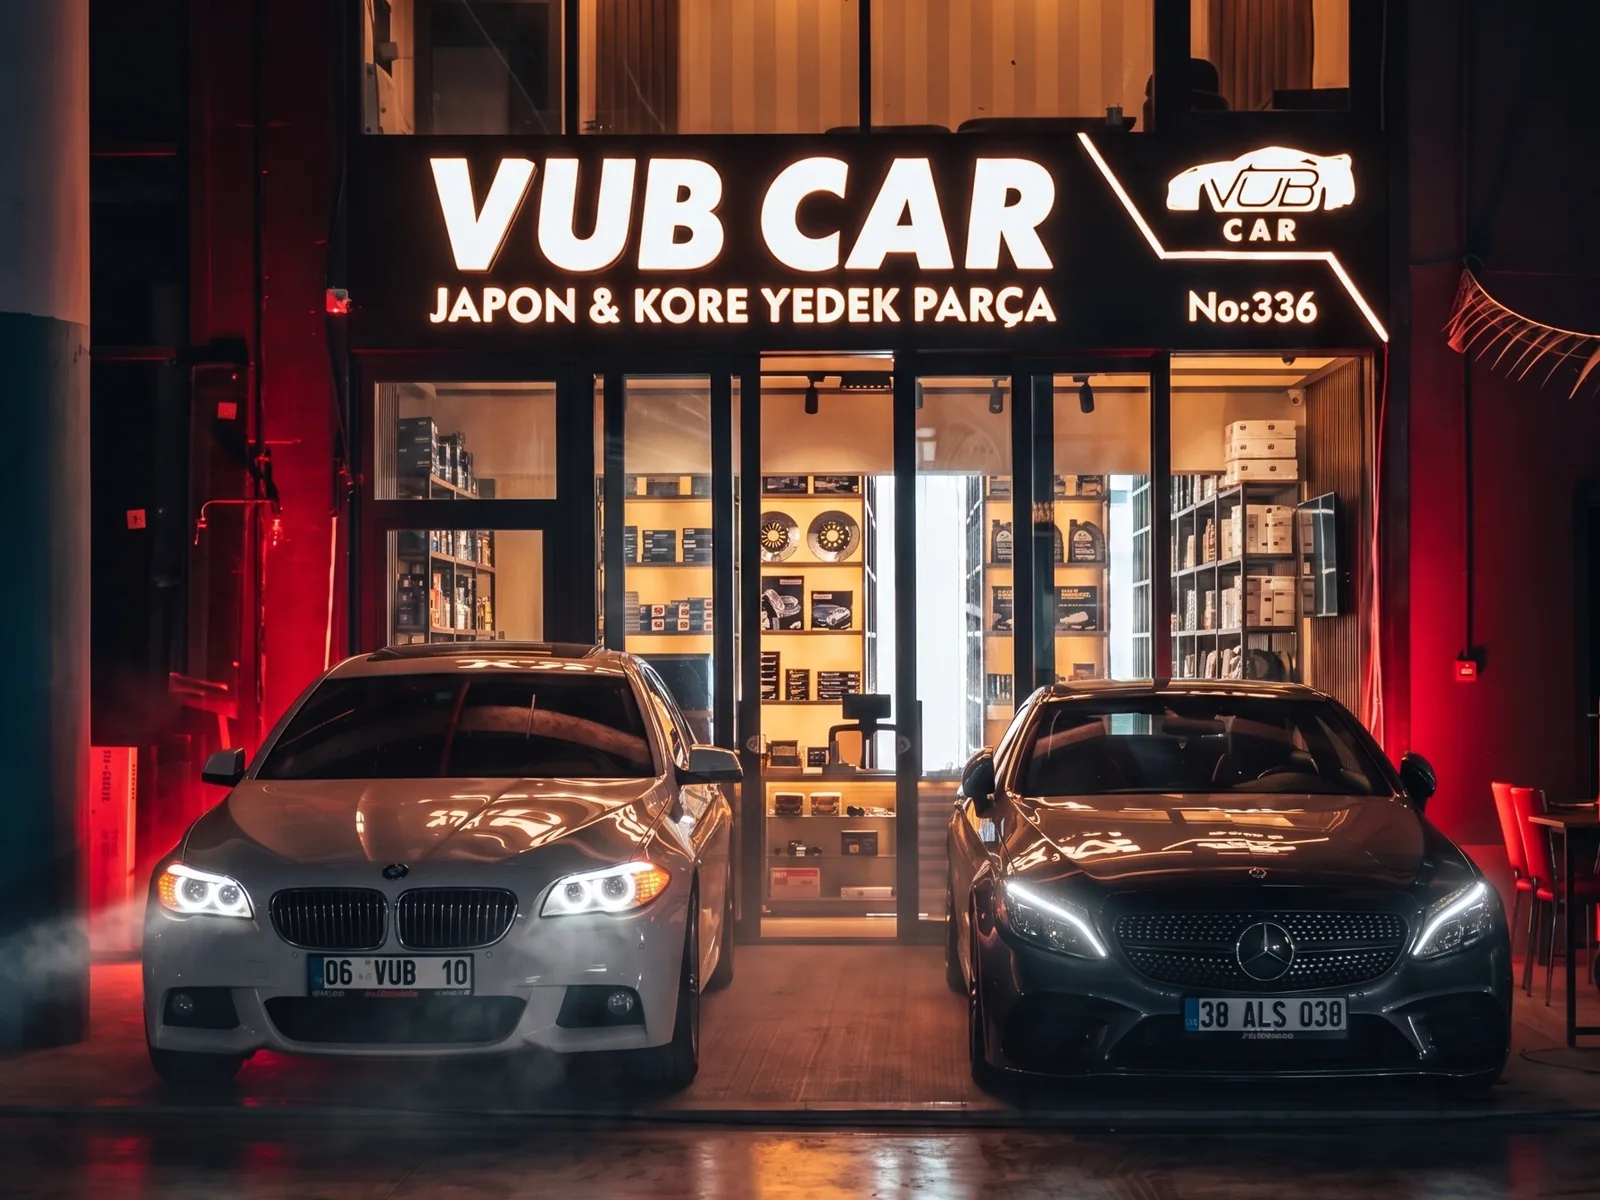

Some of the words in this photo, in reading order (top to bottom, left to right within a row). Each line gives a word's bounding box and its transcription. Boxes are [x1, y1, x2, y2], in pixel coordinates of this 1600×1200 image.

[1208, 164, 1320, 208] VUB
[429, 157, 725, 272] VUB
[760, 156, 1056, 272] CAR
[1222, 217, 1297, 243] CAR
[429, 287, 576, 324] JAPON
[588, 287, 620, 324] &
[634, 287, 749, 324] KORE
[760, 287, 900, 324] YEDEK
[914, 286, 1057, 329] PARÇA
[1188, 289, 1319, 324] No:336
[325, 959, 352, 986] 06
[374, 959, 417, 986] VUB
[442, 959, 468, 986] 10
[1200, 1000, 1229, 1028] 38
[1242, 1000, 1288, 1028] ALS
[1300, 1000, 1342, 1028] 038
